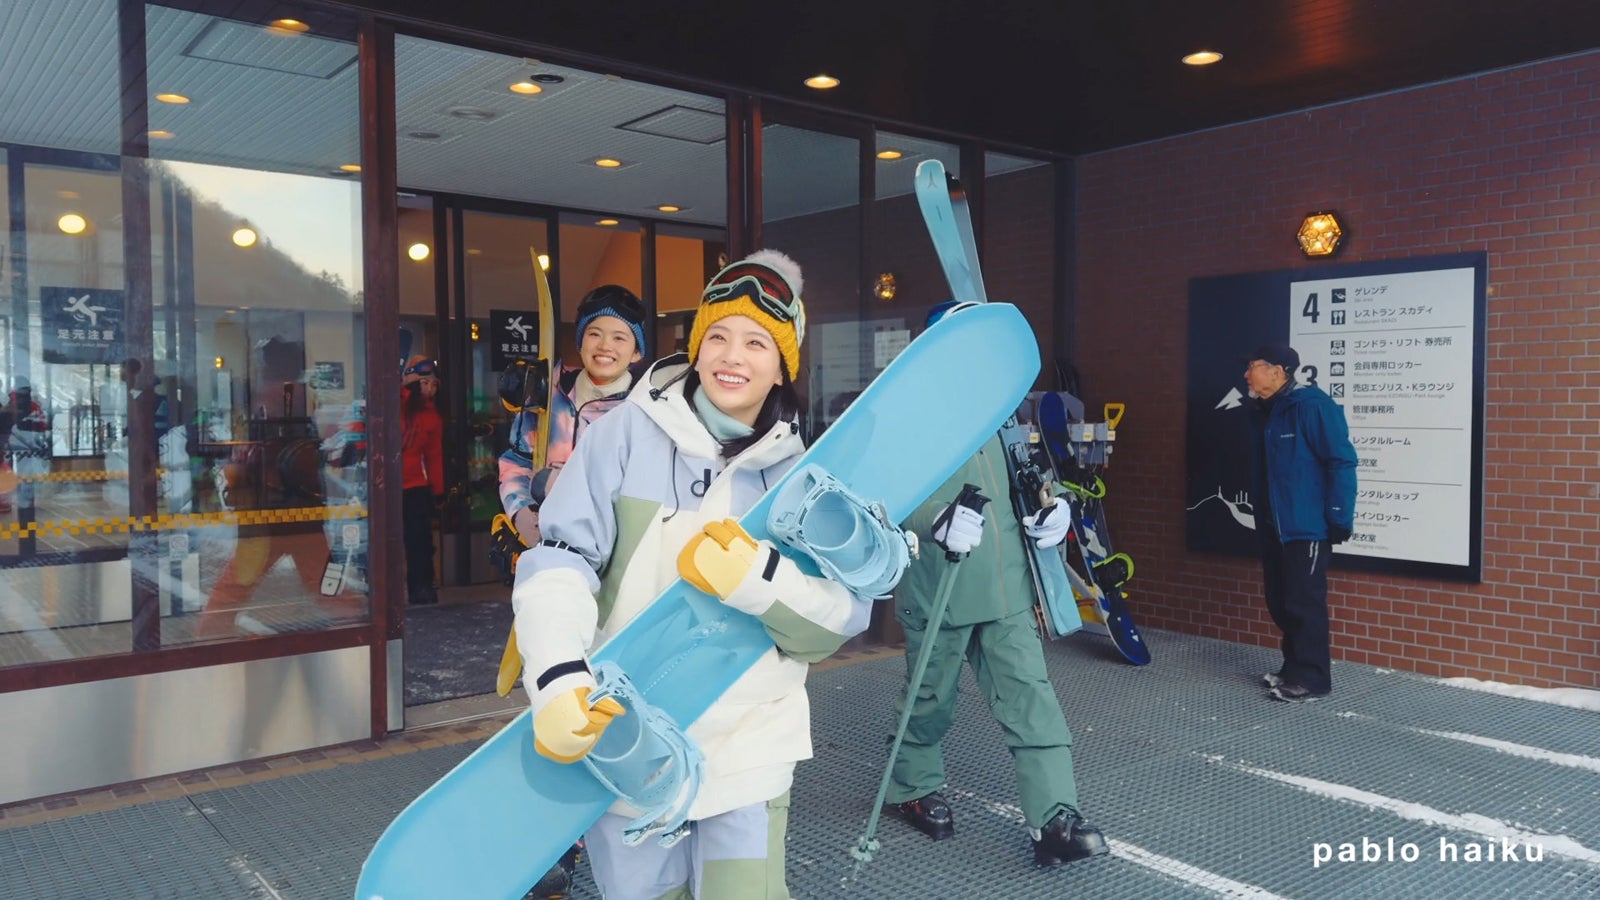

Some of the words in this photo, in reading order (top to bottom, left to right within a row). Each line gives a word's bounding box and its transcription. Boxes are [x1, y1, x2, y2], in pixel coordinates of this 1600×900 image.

[1354, 286, 1389, 296] ゲレンデ
[1302, 293, 1320, 323] 4
[1354, 308, 1396, 318] レストラン
[1399, 306, 1433, 317] スカディ
[1354, 338, 1421, 349] ゴンドラ・リフト
[1353, 361, 1422, 371] 会員専用ロッカー
[1301, 365, 1319, 387] 3
[1352, 405, 1395, 414] 管理事務所
[1352, 436, 1411, 446] レンタルルーム
[1357, 490, 1420, 501] ンタルショップ
